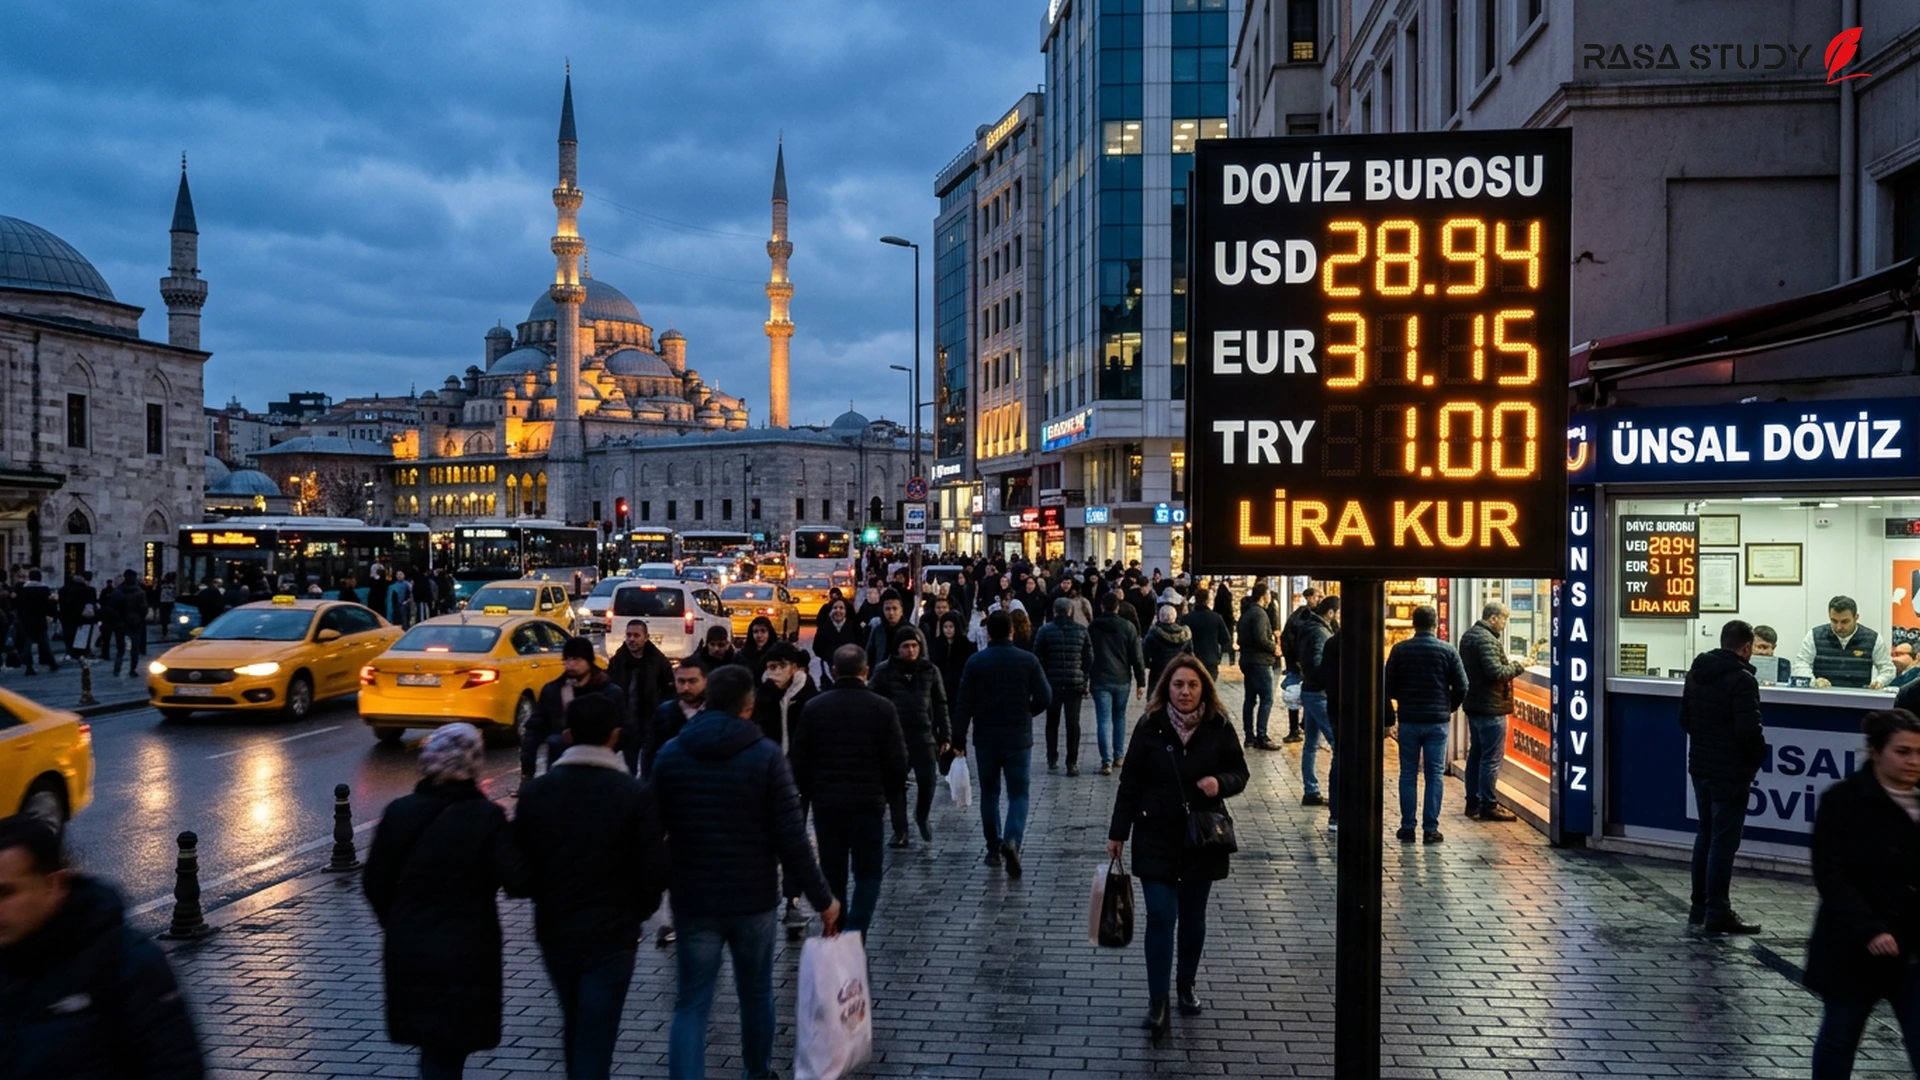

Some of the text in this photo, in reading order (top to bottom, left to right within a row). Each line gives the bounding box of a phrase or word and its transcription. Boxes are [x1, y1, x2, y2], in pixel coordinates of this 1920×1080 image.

[1223, 152, 1544, 204] DOVİZ BUROSU
[1215, 218, 1540, 296] USD 28.94
[1213, 309, 1538, 388] EUR 31.15
[1213, 420, 1315, 464] TRY
[1404, 401, 1537, 478] 1.00
[1612, 421, 1749, 464] ÜNSAL
[1763, 411, 1901, 461] DÖVİZ
[1239, 489, 1520, 548] LİRA KUR
[1626, 582, 1648, 592] TRY
[1663, 600, 1690, 612] KUR
